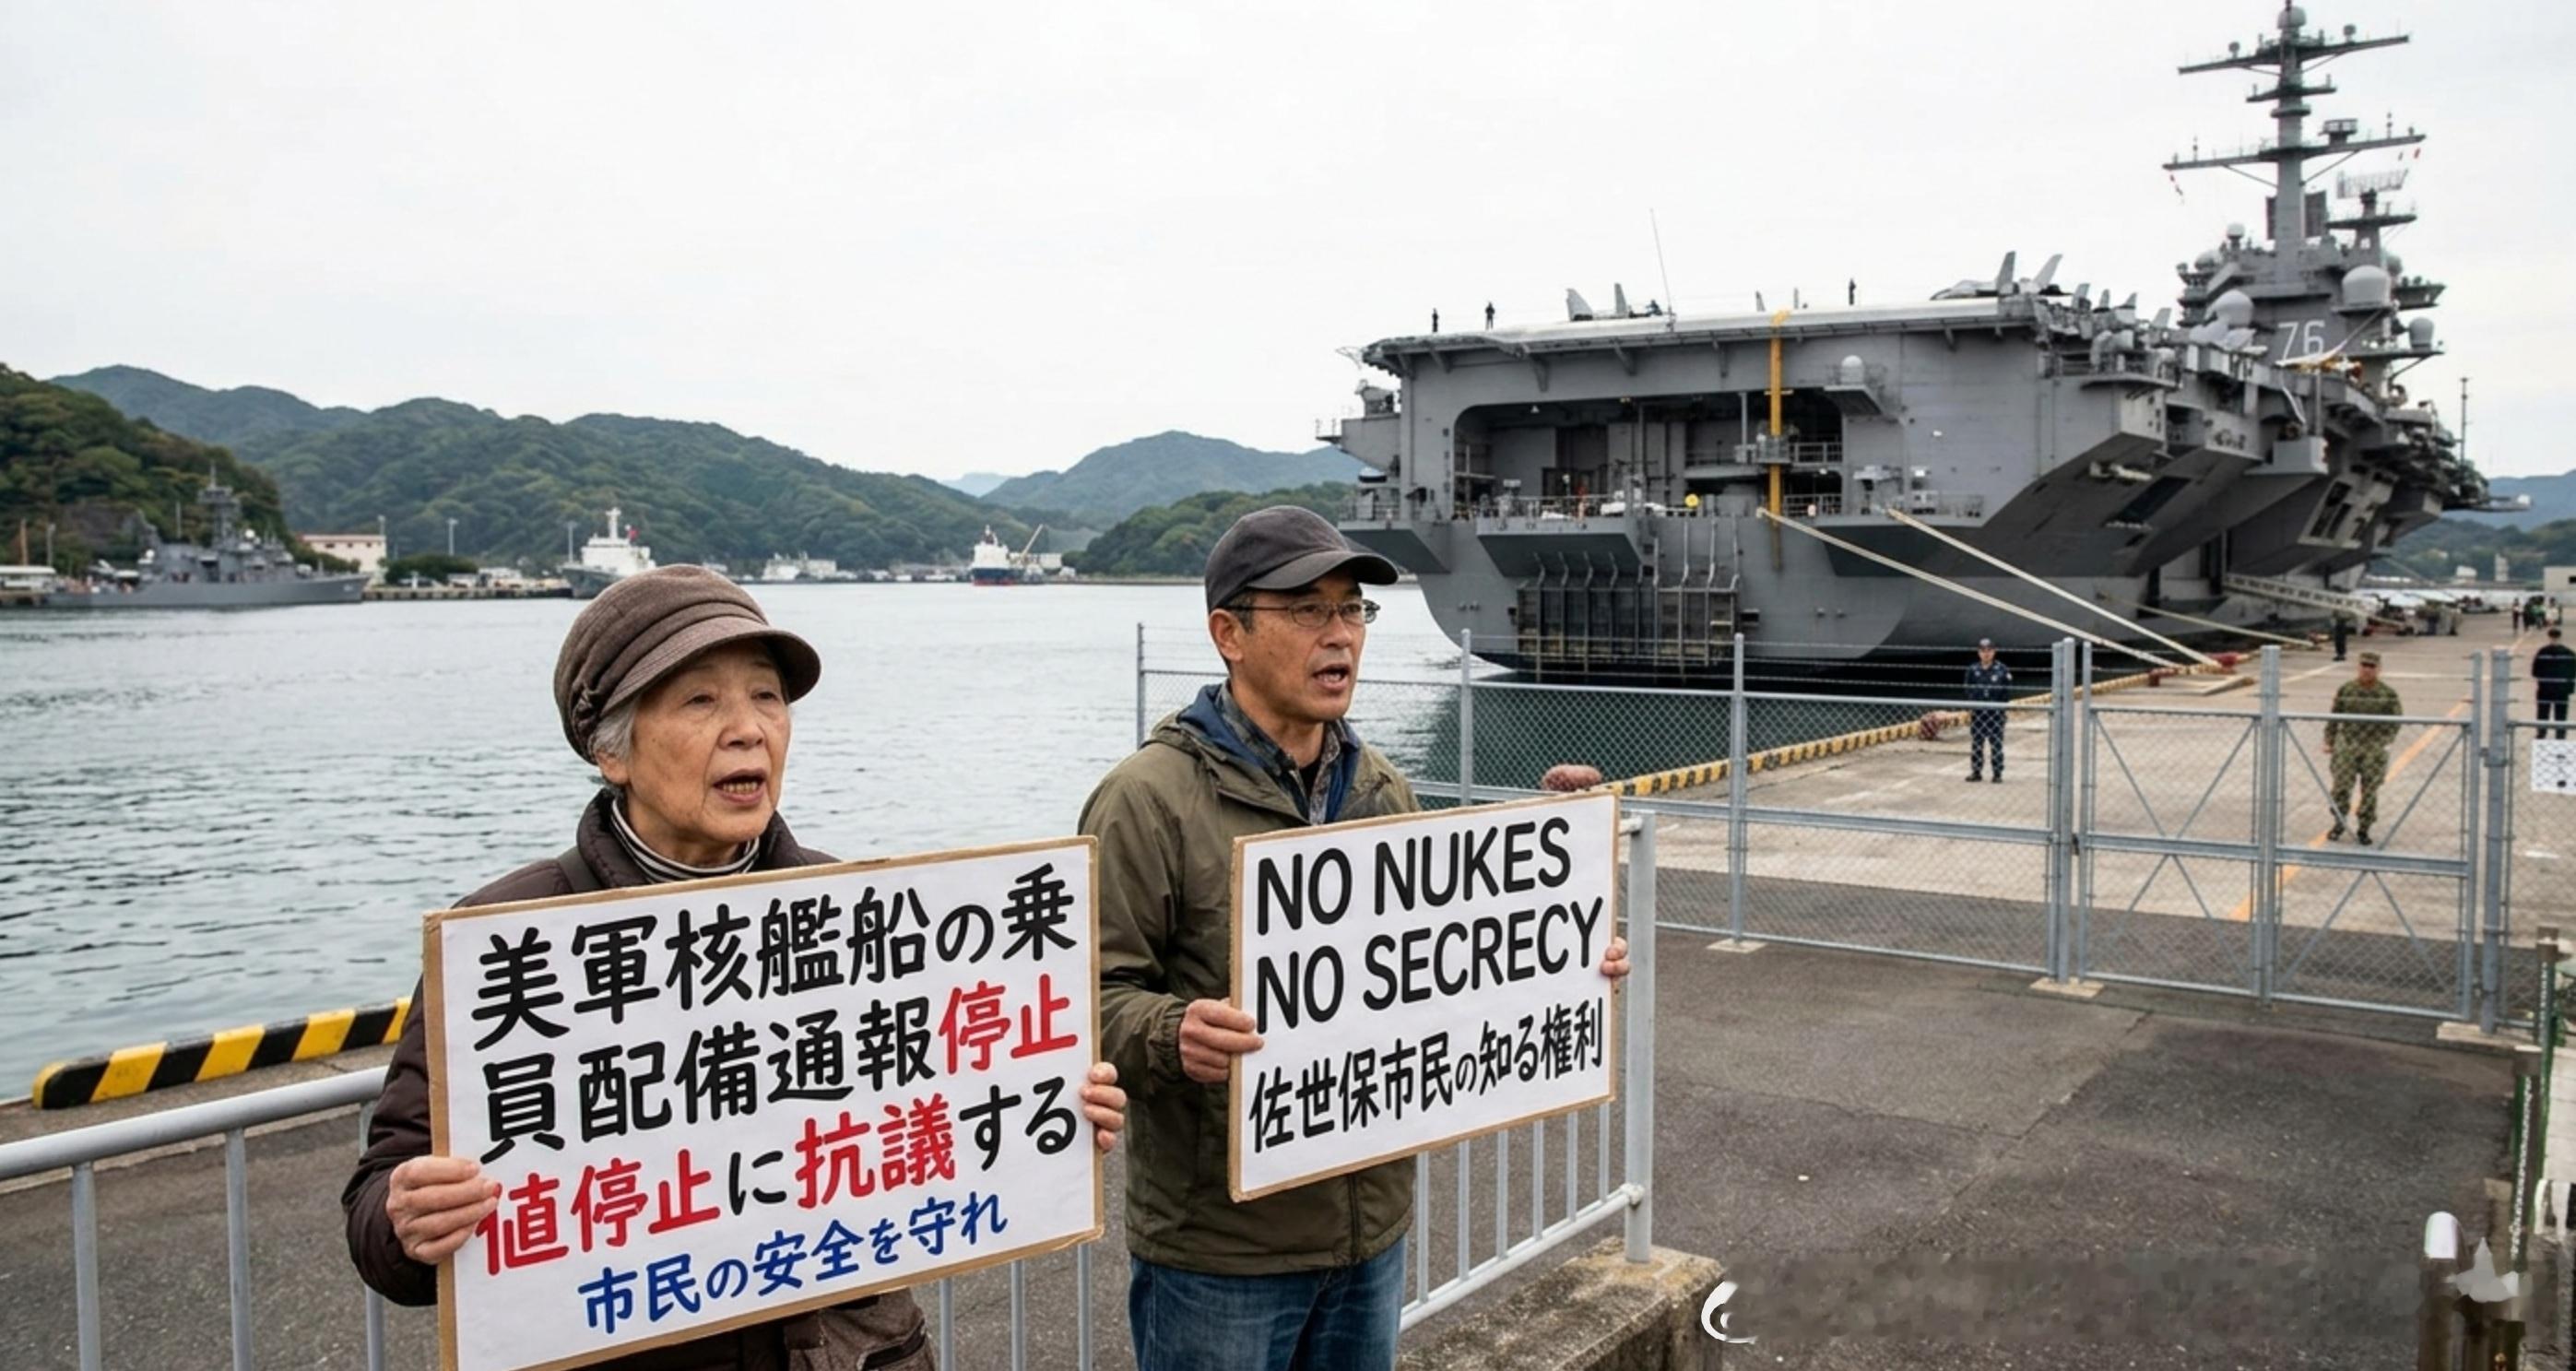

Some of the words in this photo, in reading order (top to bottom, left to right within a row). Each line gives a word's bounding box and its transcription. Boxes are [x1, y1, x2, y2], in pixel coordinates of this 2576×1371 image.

[2277, 320, 2325, 363] 76
[1258, 847, 1353, 936] NO
[1374, 817, 1571, 916] NUKES
[471, 862, 1078, 1052] 美軍核艦船の乗
[1256, 945, 1345, 1034] NO
[1363, 896, 1603, 1011] SECRECY
[479, 974, 1078, 1165] 員配備通報停止
[1248, 997, 1602, 1153] 佐世保市民の知る権利
[475, 1076, 1077, 1276] 値停止に抗議する
[577, 1191, 1008, 1335] 市民の安全を守れ
